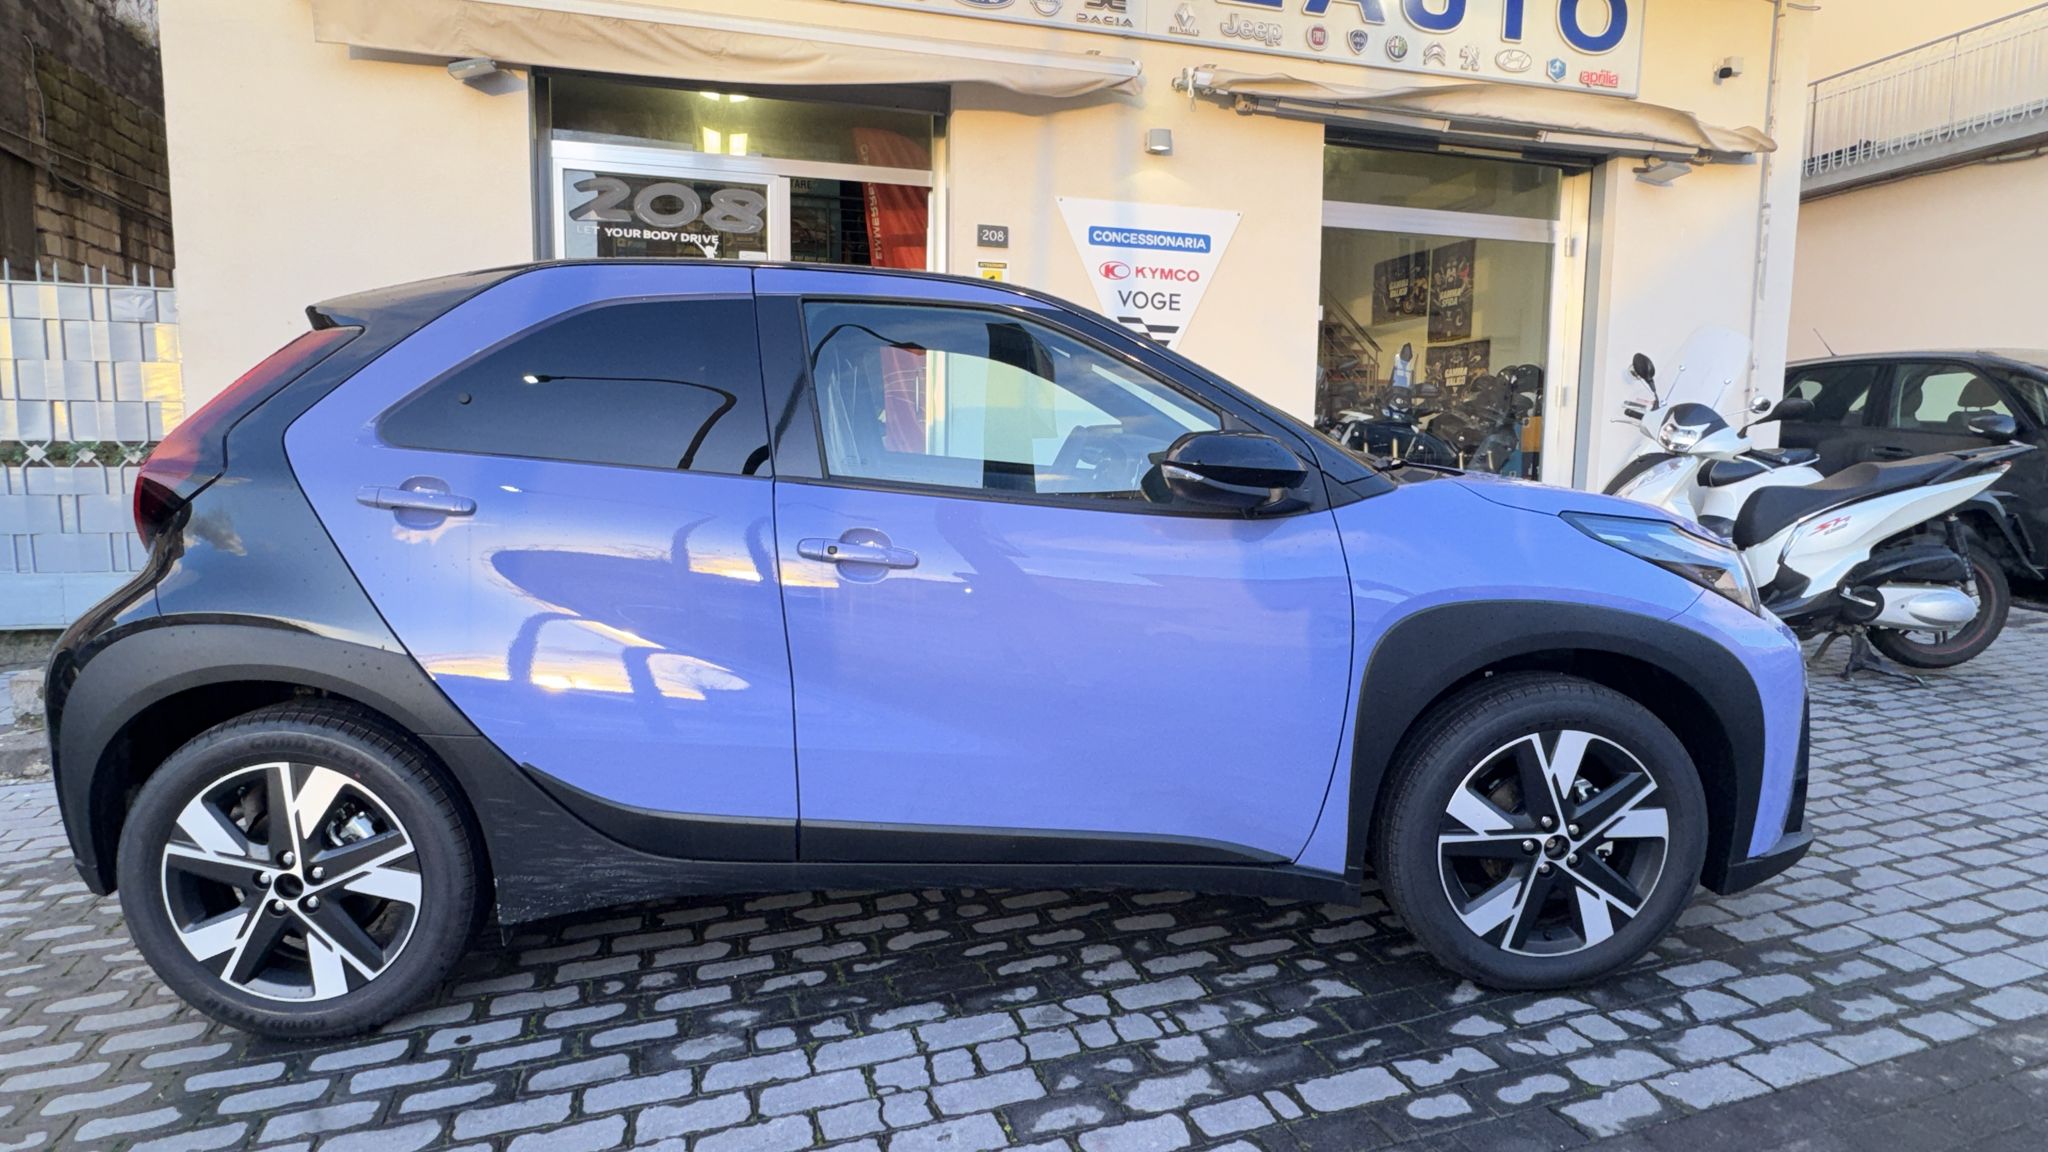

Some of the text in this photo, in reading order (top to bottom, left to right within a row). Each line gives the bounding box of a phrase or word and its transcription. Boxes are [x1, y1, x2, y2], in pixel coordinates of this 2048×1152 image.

[1076, 13, 1134, 27] DACIA
[1220, 14, 1282, 46] Jeep
[1581, 70, 1617, 87] aprilia
[568, 176, 767, 234] 208
[576, 226, 720, 244] LET YOUR BODY DRIVE
[982, 229, 1005, 242] 208
[1092, 230, 1207, 250] CONCESSIONARIA
[1135, 266, 1200, 283] KYMCO
[1117, 290, 1182, 311] VOGE
